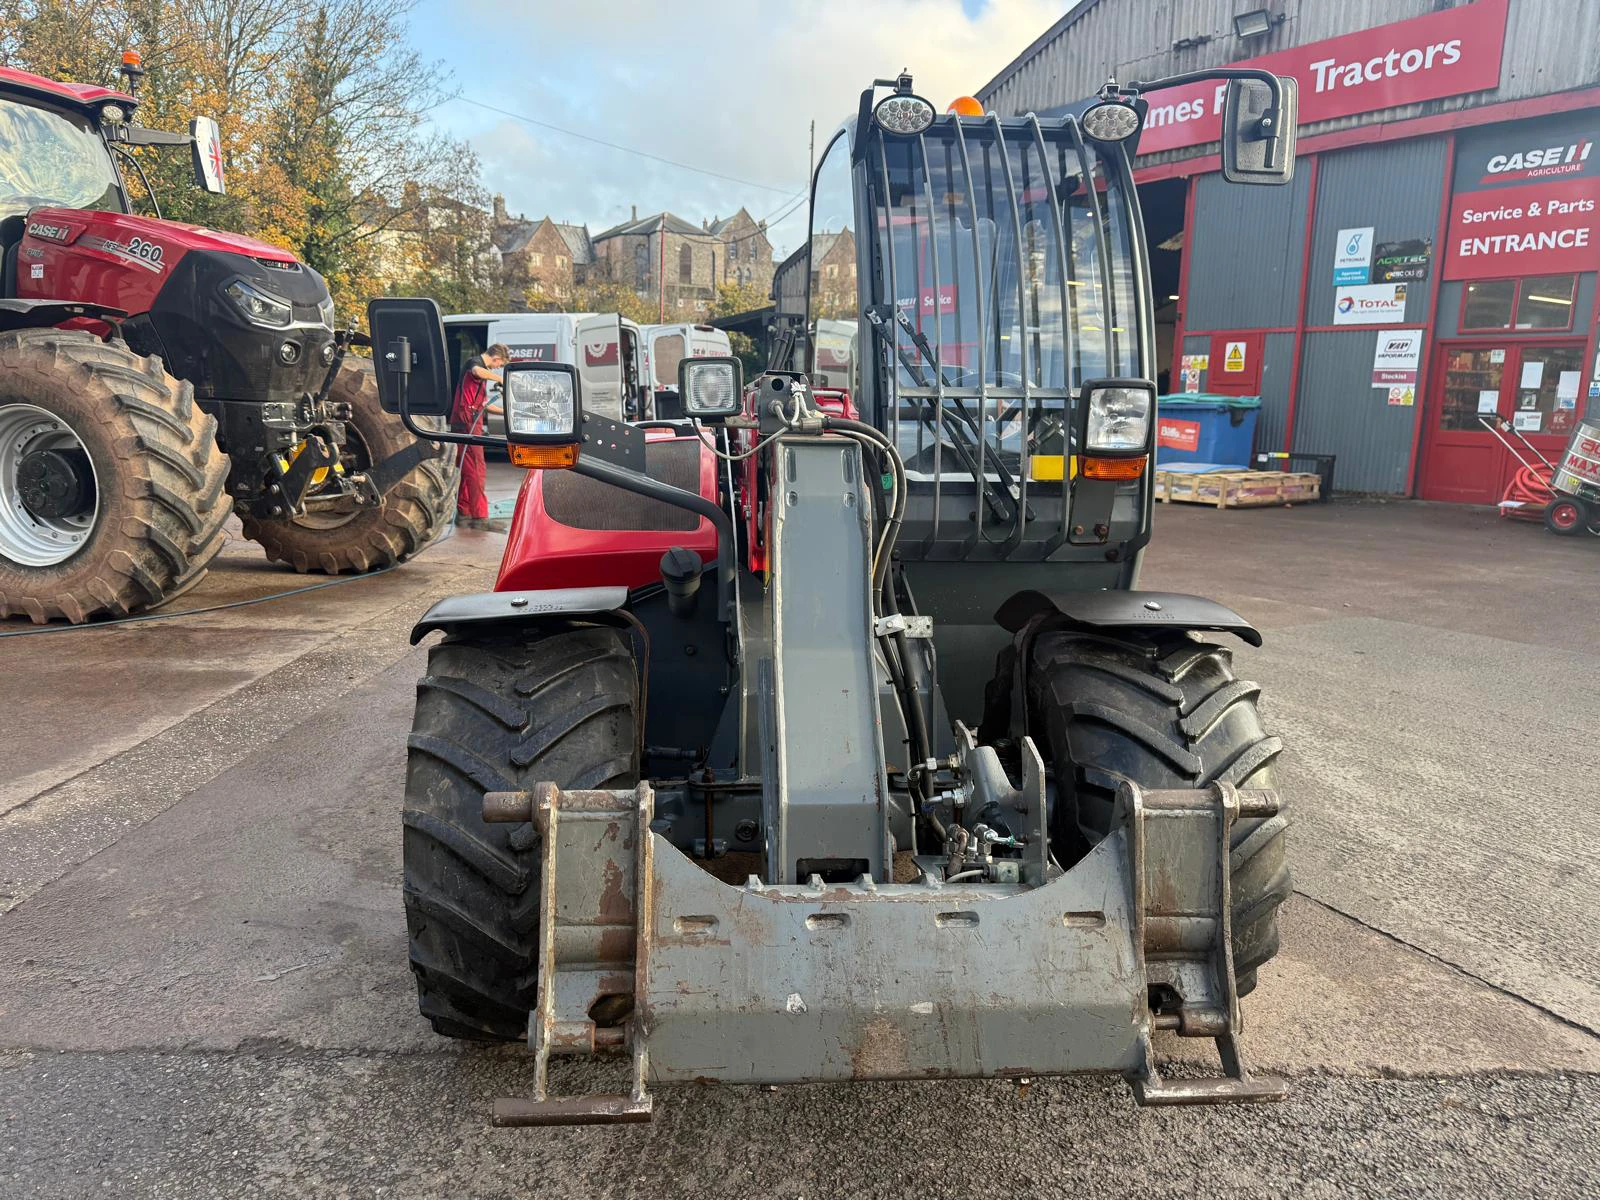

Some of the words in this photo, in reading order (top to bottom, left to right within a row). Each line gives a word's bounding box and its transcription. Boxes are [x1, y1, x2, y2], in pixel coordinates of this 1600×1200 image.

[1141, 97, 1203, 129] mes
[1309, 38, 1462, 93] Tractors
[1487, 147, 1564, 174] CASE
[1527, 164, 1581, 177] AGRICULTURE
[1462, 206, 1522, 223] Service
[1527, 202, 1541, 217] &
[1547, 199, 1594, 215] Parts
[28, 223, 56, 238] CASE
[1460, 228, 1590, 256] ENTRANCE
[127, 237, 163, 262] 260
[508, 349, 533, 358] CASE
